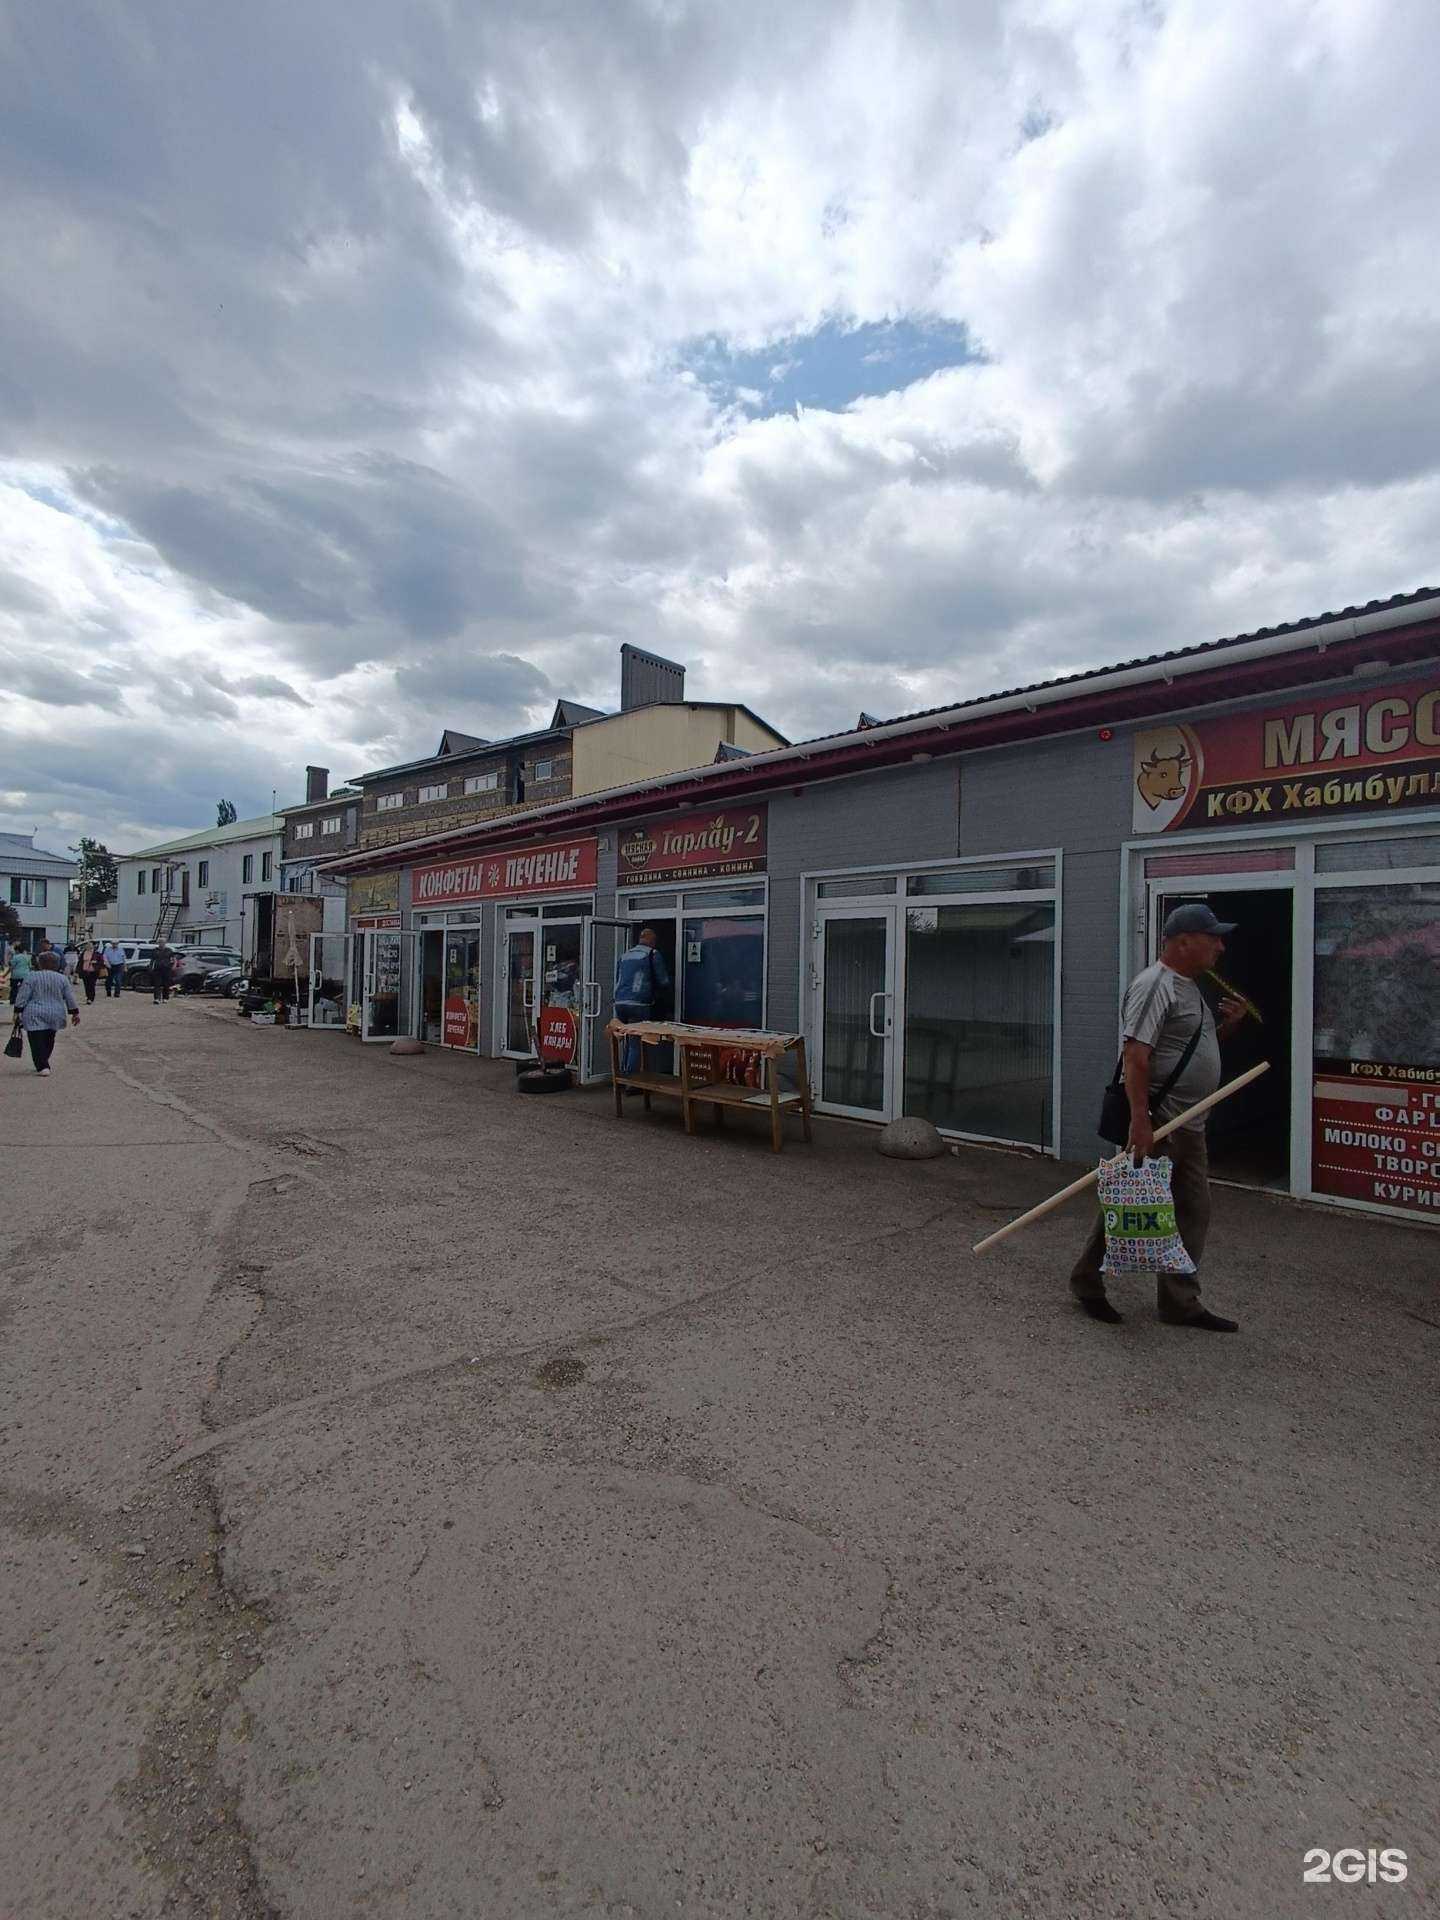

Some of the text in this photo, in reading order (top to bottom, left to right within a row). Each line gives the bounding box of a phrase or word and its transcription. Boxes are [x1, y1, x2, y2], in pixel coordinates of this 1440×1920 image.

[1207, 787, 1273, 818] КФХ
[419, 863, 484, 898] КОНФЕТЫ
[505, 849, 580, 888] ПЕЧЕНЬЕ
[720, 861, 754, 874] КОНИНА
[549, 1021, 567, 1034] ХЛЕБ
[1350, 1063, 1384, 1076] КФХ
[1325, 1128, 1440, 1158] МОЛОКО С
[1123, 1211, 1160, 1232] FIX
